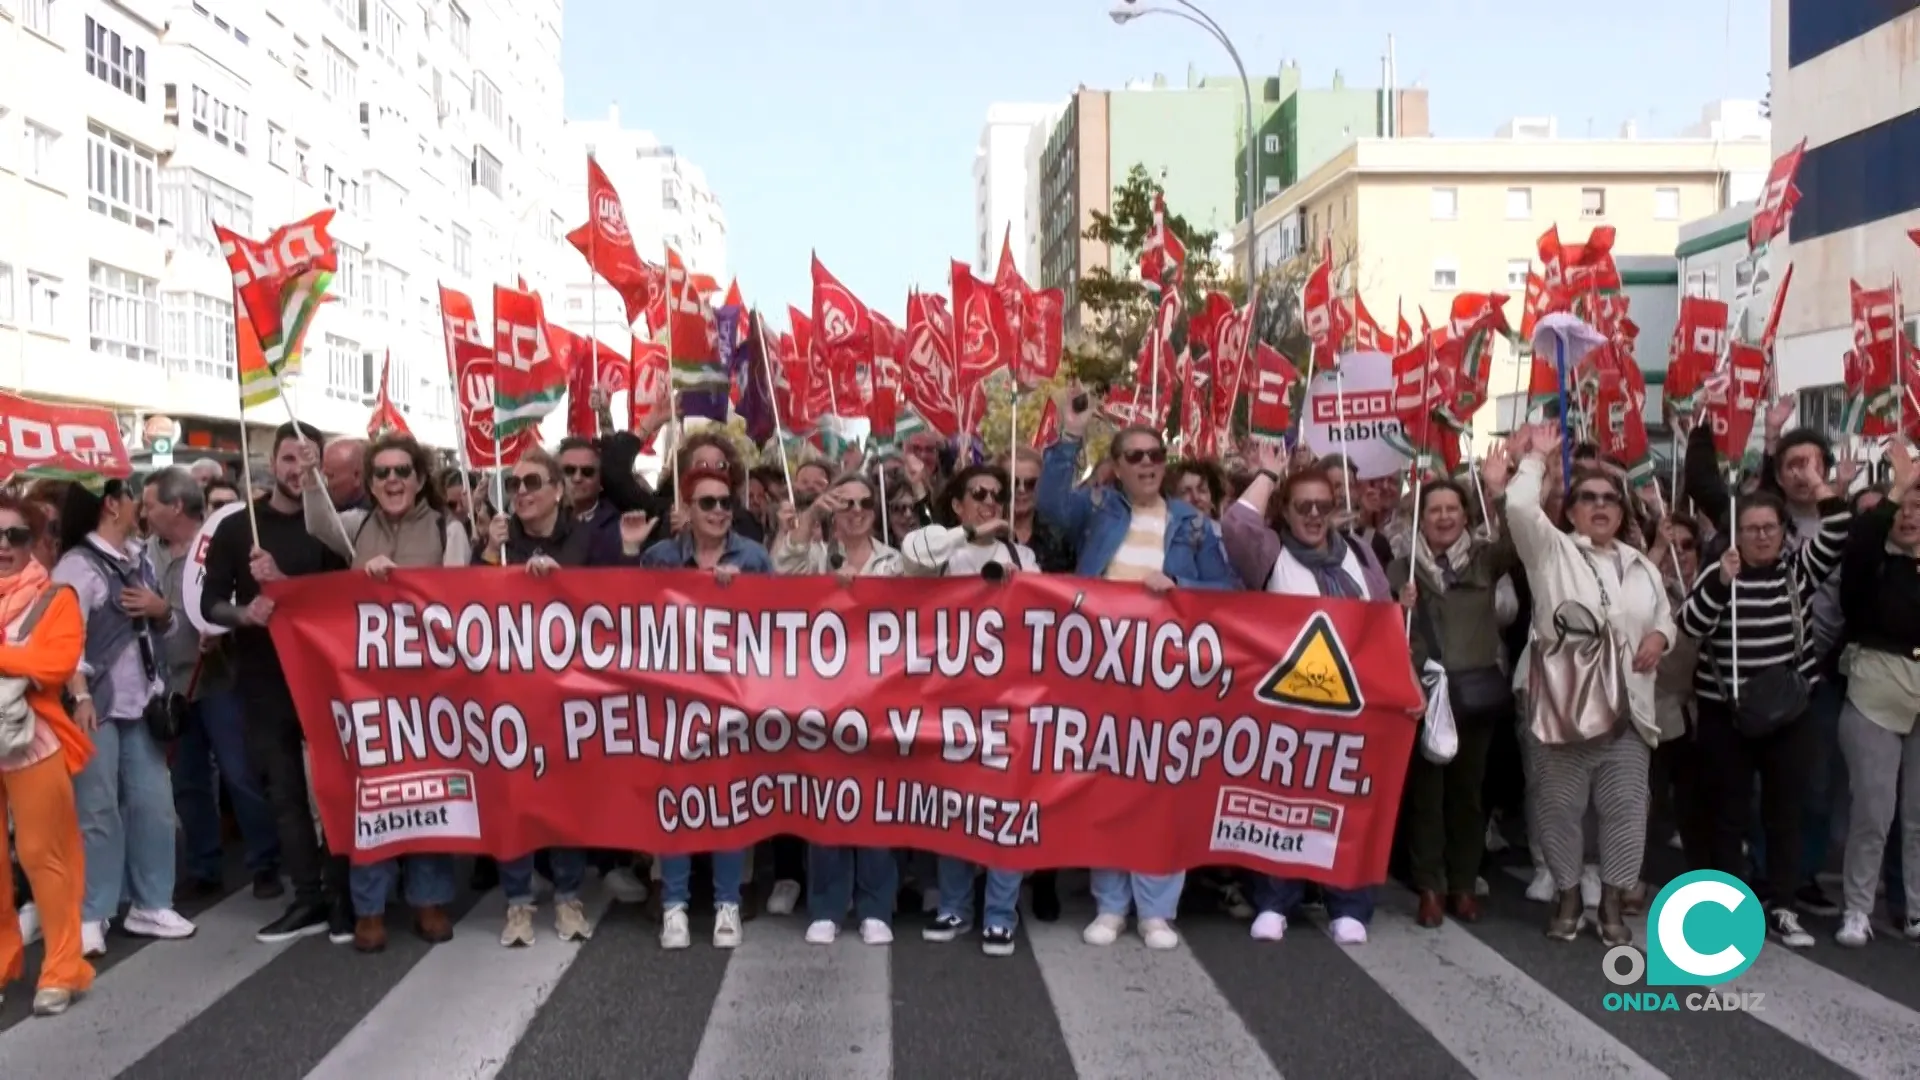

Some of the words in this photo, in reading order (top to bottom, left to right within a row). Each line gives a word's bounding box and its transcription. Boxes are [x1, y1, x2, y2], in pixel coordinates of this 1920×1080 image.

[1318, 395, 1386, 419] CCOO
[357, 602, 849, 678] RECONOCIMIENTO
[868, 609, 1004, 678] PLUS
[1025, 592, 1234, 699] TÓXICO,
[331, 697, 546, 777] PENOSO,
[563, 695, 867, 761] PELIGROSO
[889, 708, 921, 755] Y
[942, 707, 1010, 769] DE
[1029, 706, 1371, 796] TRANSPORTE.
[361, 779, 444, 808] CCOO
[657, 773, 861, 832] COLECTIVO
[875, 780, 1040, 845] LIMPIEZA
[1227, 794, 1309, 825] CCOO
[358, 805, 449, 837] hábitat
[1217, 820, 1304, 852] hábitat
